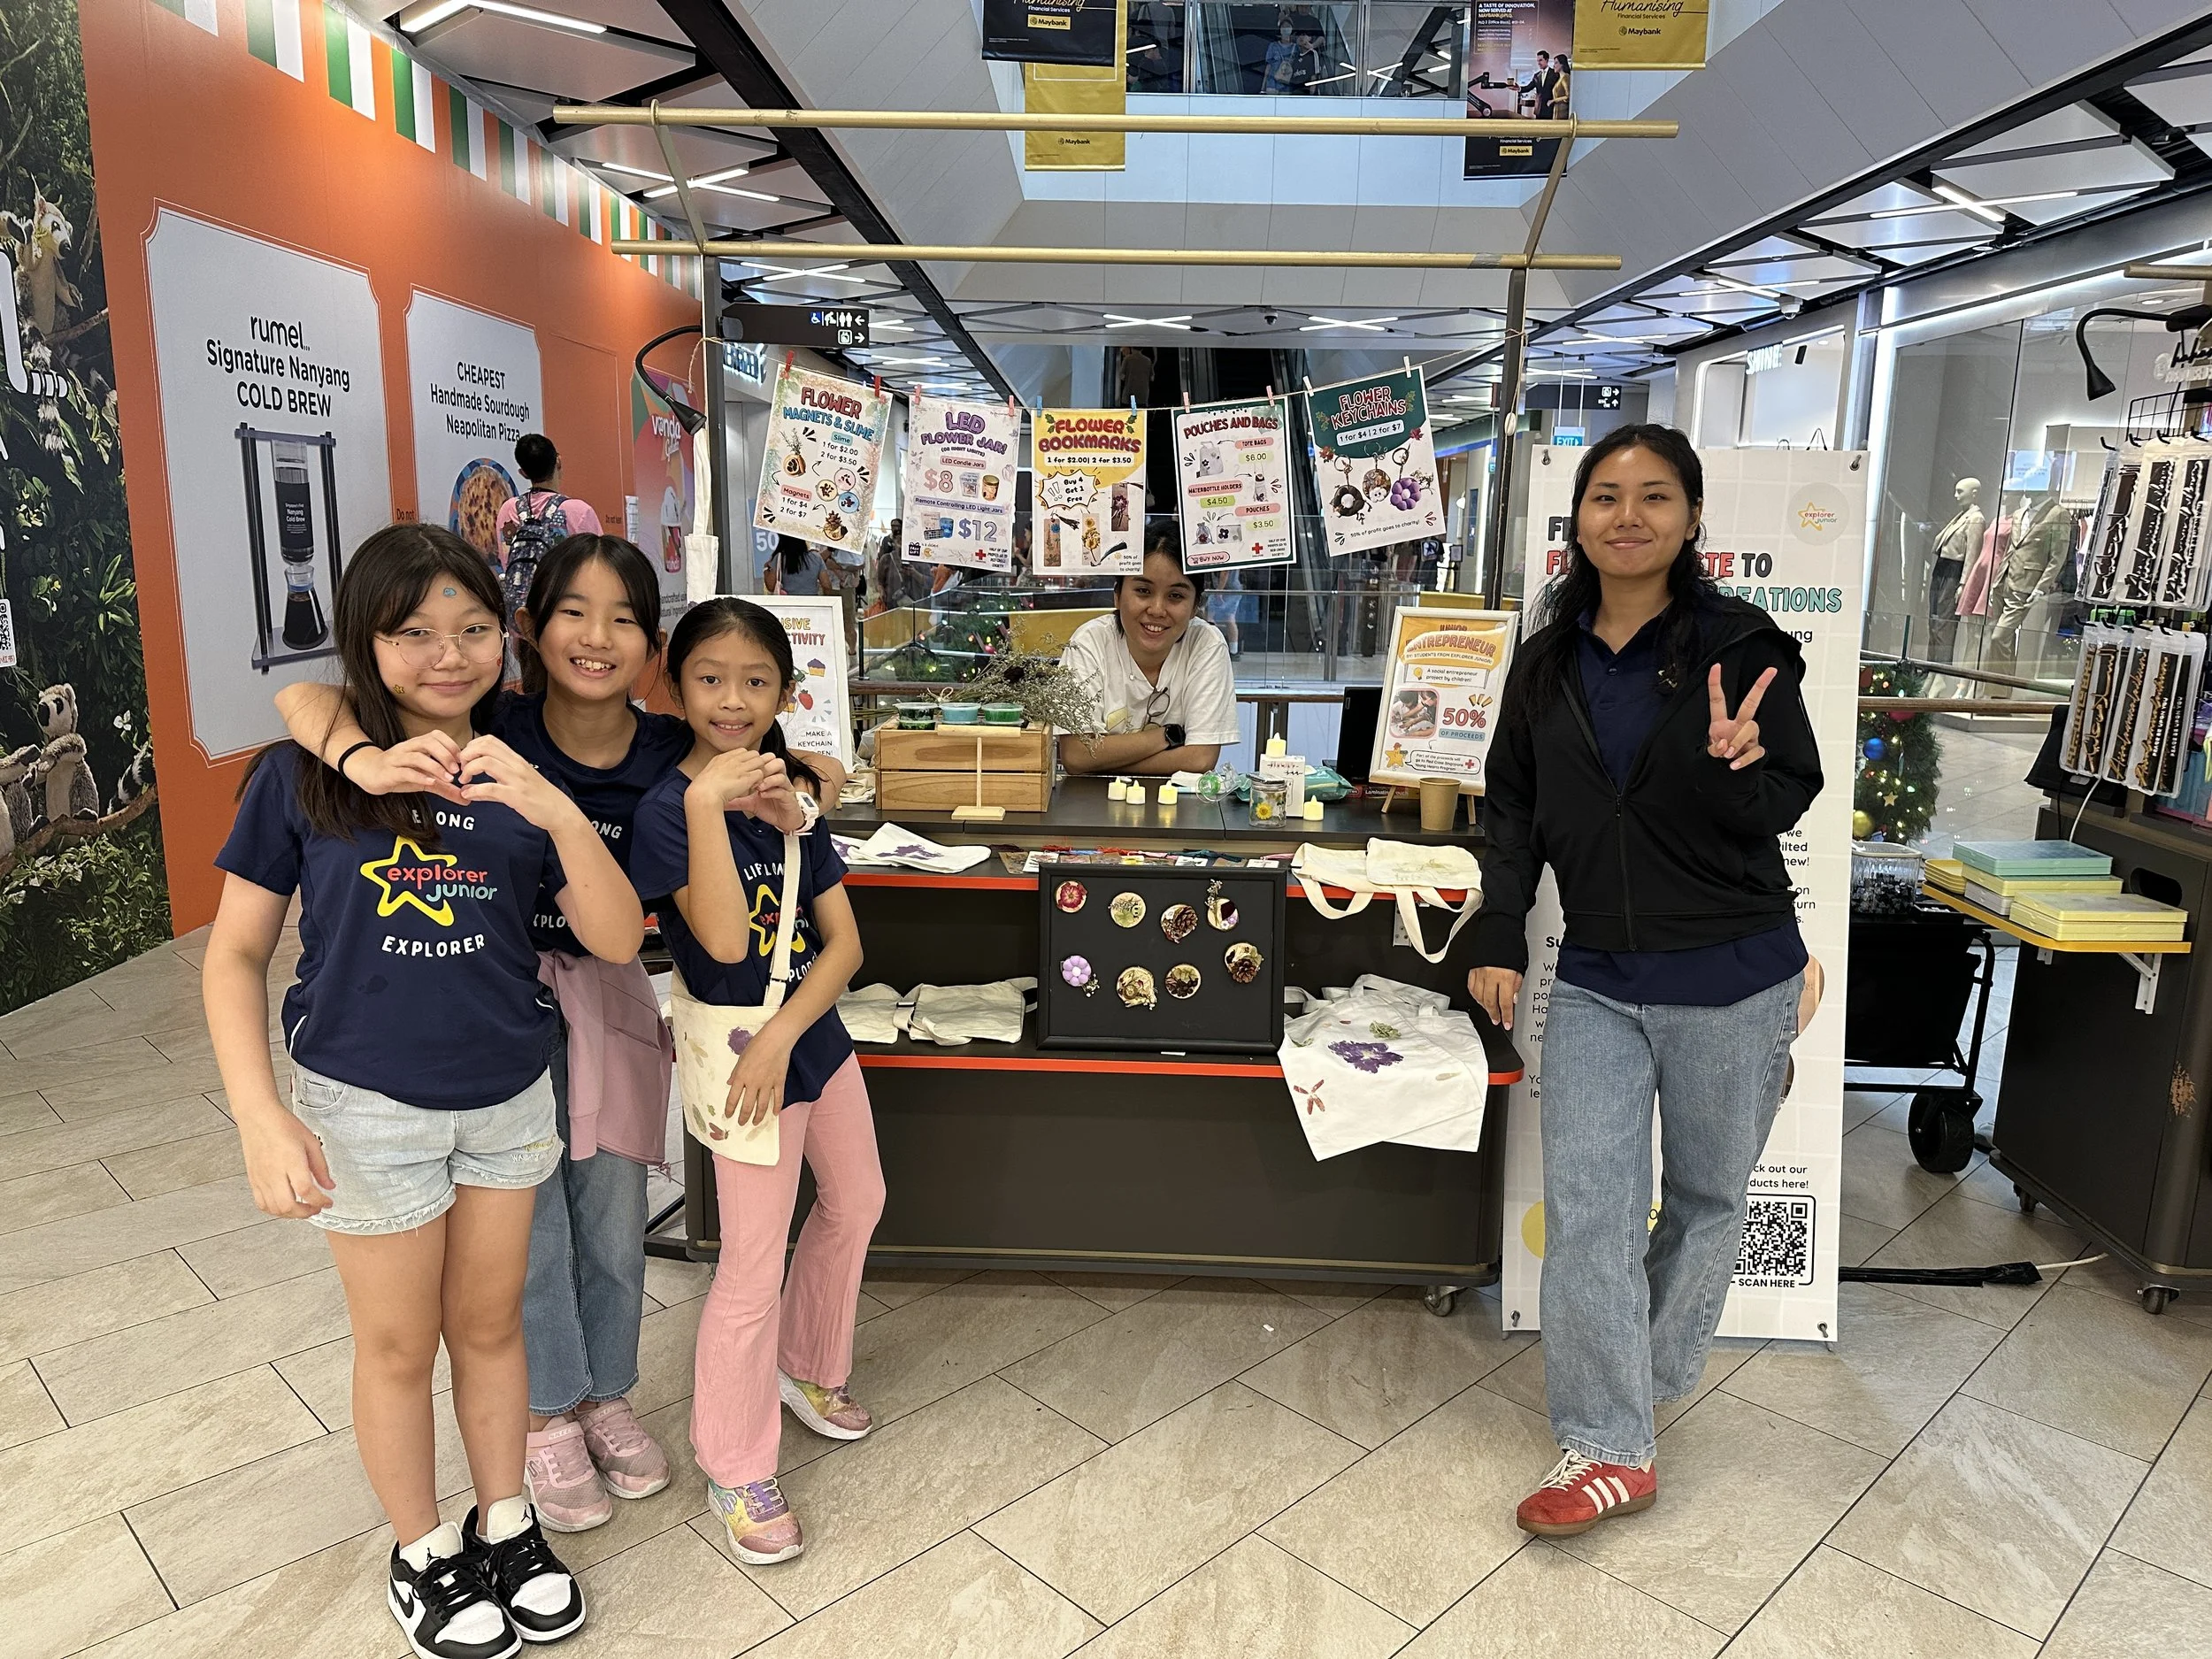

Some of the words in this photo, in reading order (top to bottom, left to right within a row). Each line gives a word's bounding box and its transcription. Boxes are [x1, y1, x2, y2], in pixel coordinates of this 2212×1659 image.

[206, 339, 285, 377] Signature
[289, 355, 349, 393] Nanyang
[457, 361, 505, 390] CHEAPEST
[237, 381, 283, 411] COLD
[288, 388, 332, 418] BREW
[430, 383, 482, 411] Handmade
[484, 394, 530, 423] Sourdough
[801, 387, 863, 419] FLOWER
[1339, 386, 1392, 411] FLOWER
[783, 407, 833, 426] MAGNETS
[833, 417, 842, 430] &
[844, 419, 875, 442] SLIME
[945, 411, 986, 434] LED
[1054, 418, 1125, 434] FLOWER
[1331, 399, 1407, 431] KEYCHAINS
[446, 413, 496, 439] Neapolitan
[498, 422, 520, 442] Pizza
[1183, 418, 1228, 439] POUCHES
[1229, 416, 1252, 429] AND
[1252, 416, 1279, 430] BAGS
[1392, 423, 1401, 432] $7
[833, 434, 850, 444] Slime
[921, 432, 974, 445] FLOWER
[977, 437, 1008, 455] JAR!
[1039, 434, 1141, 453] BOOKMARKS
[1557, 437, 1574, 446] EXIT
[839, 445, 858, 456] $2.00
[839, 455, 857, 465] $3.50
[1246, 453, 1267, 462] $6.00
[924, 469, 954, 493] $8
[1188, 485, 1221, 494] WATERBOTTLE
[783, 488, 810, 499] Magnets
[396, 509, 404, 520] Do
[405, 510, 415, 520] not
[936, 501, 965, 510] Controlling
[958, 518, 997, 542] $12
[1741, 553, 1773, 578] TO
[1406, 634, 1496, 657] ENTREPRENEUR
[1442, 707, 1486, 728] 50%
[1450, 731, 1483, 740] PROCEEDS
[387, 864, 488, 890] explorer
[426, 884, 498, 902] junior
[381, 933, 485, 957] EXPLORER
[1768, 1165, 1786, 1174] out
[1782, 1179, 1809, 1189] here!
[1739, 1279, 1770, 1287] SCAN
[1770, 1279, 1795, 1288] HERE
